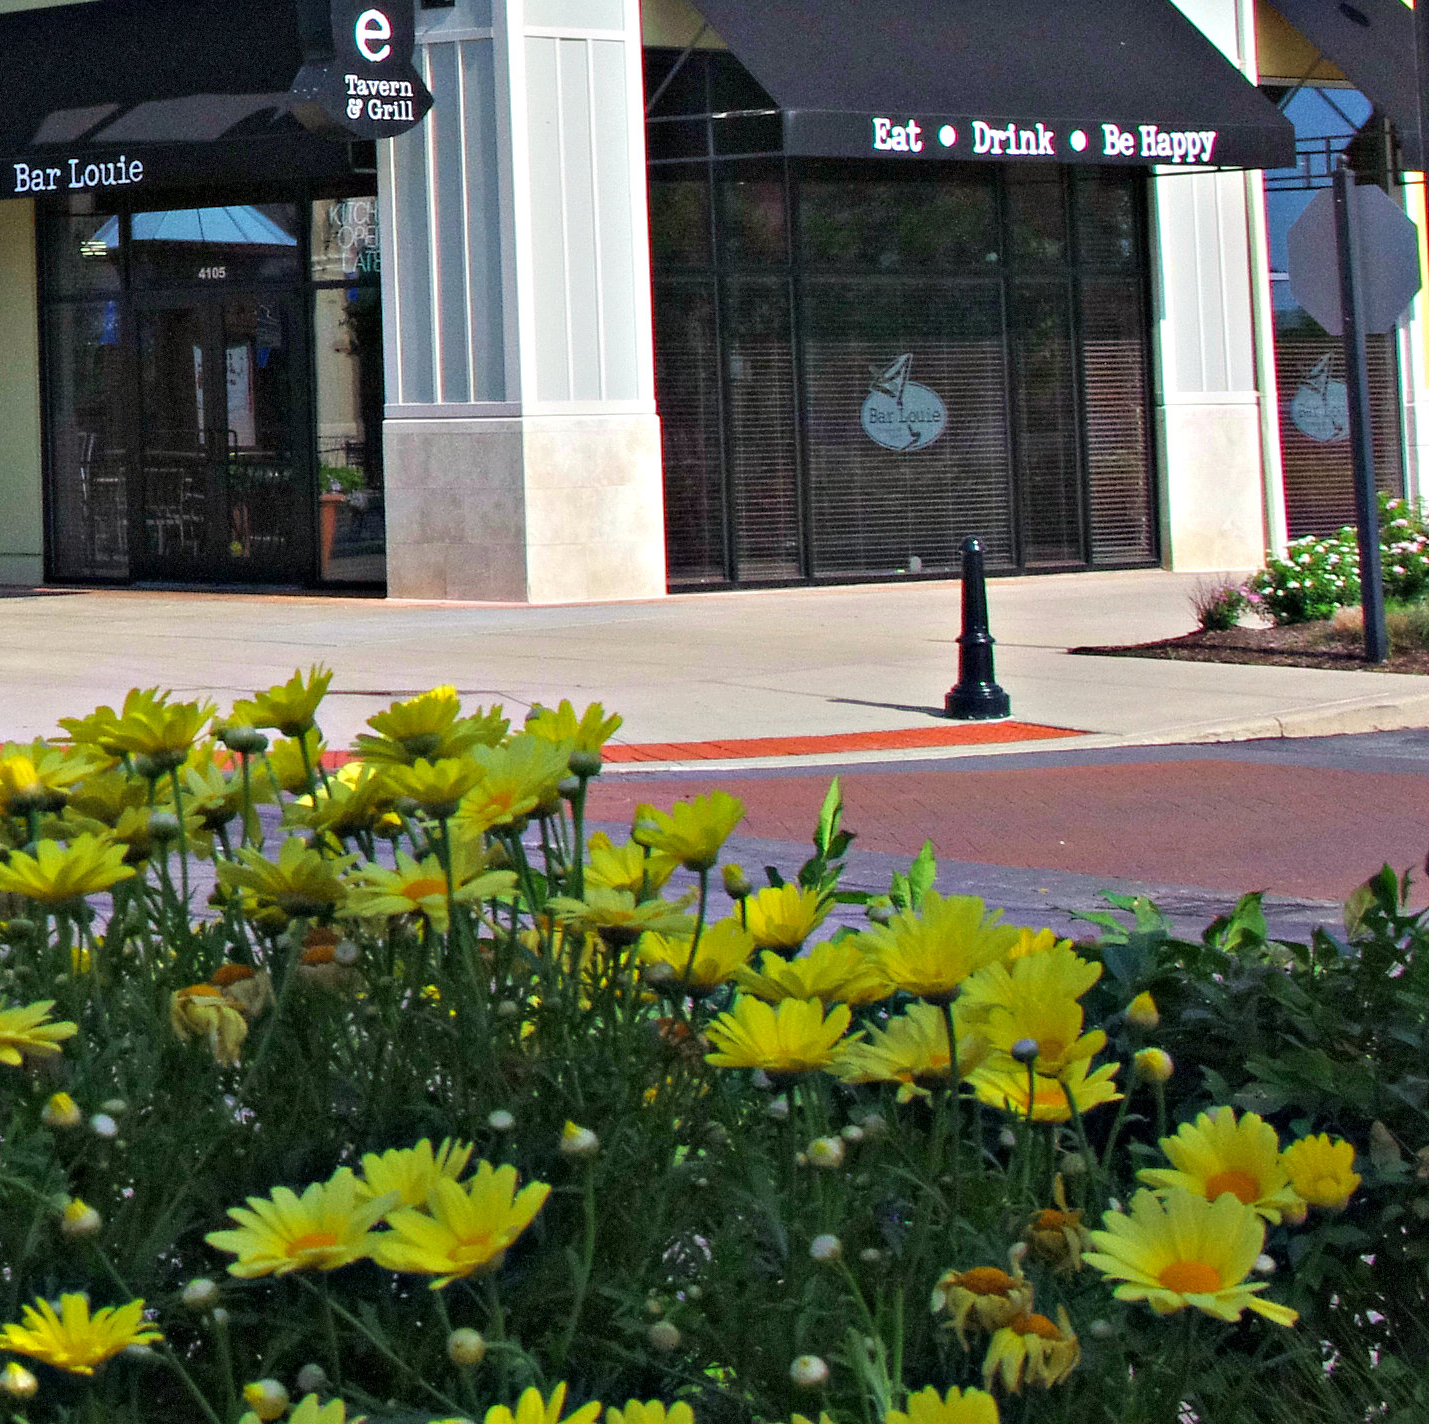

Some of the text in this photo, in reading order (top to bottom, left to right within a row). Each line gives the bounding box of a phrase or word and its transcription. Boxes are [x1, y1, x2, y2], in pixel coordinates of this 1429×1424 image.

[344, 74, 414, 96] Tavern
[346, 98, 414, 120] & Grill
[872, 117, 1215, 162] Eat Drink Be Happy
[13, 155, 144, 192] Bar Louie
[198, 266, 226, 279] 4105
[870, 407, 941, 424] Bar Louie
